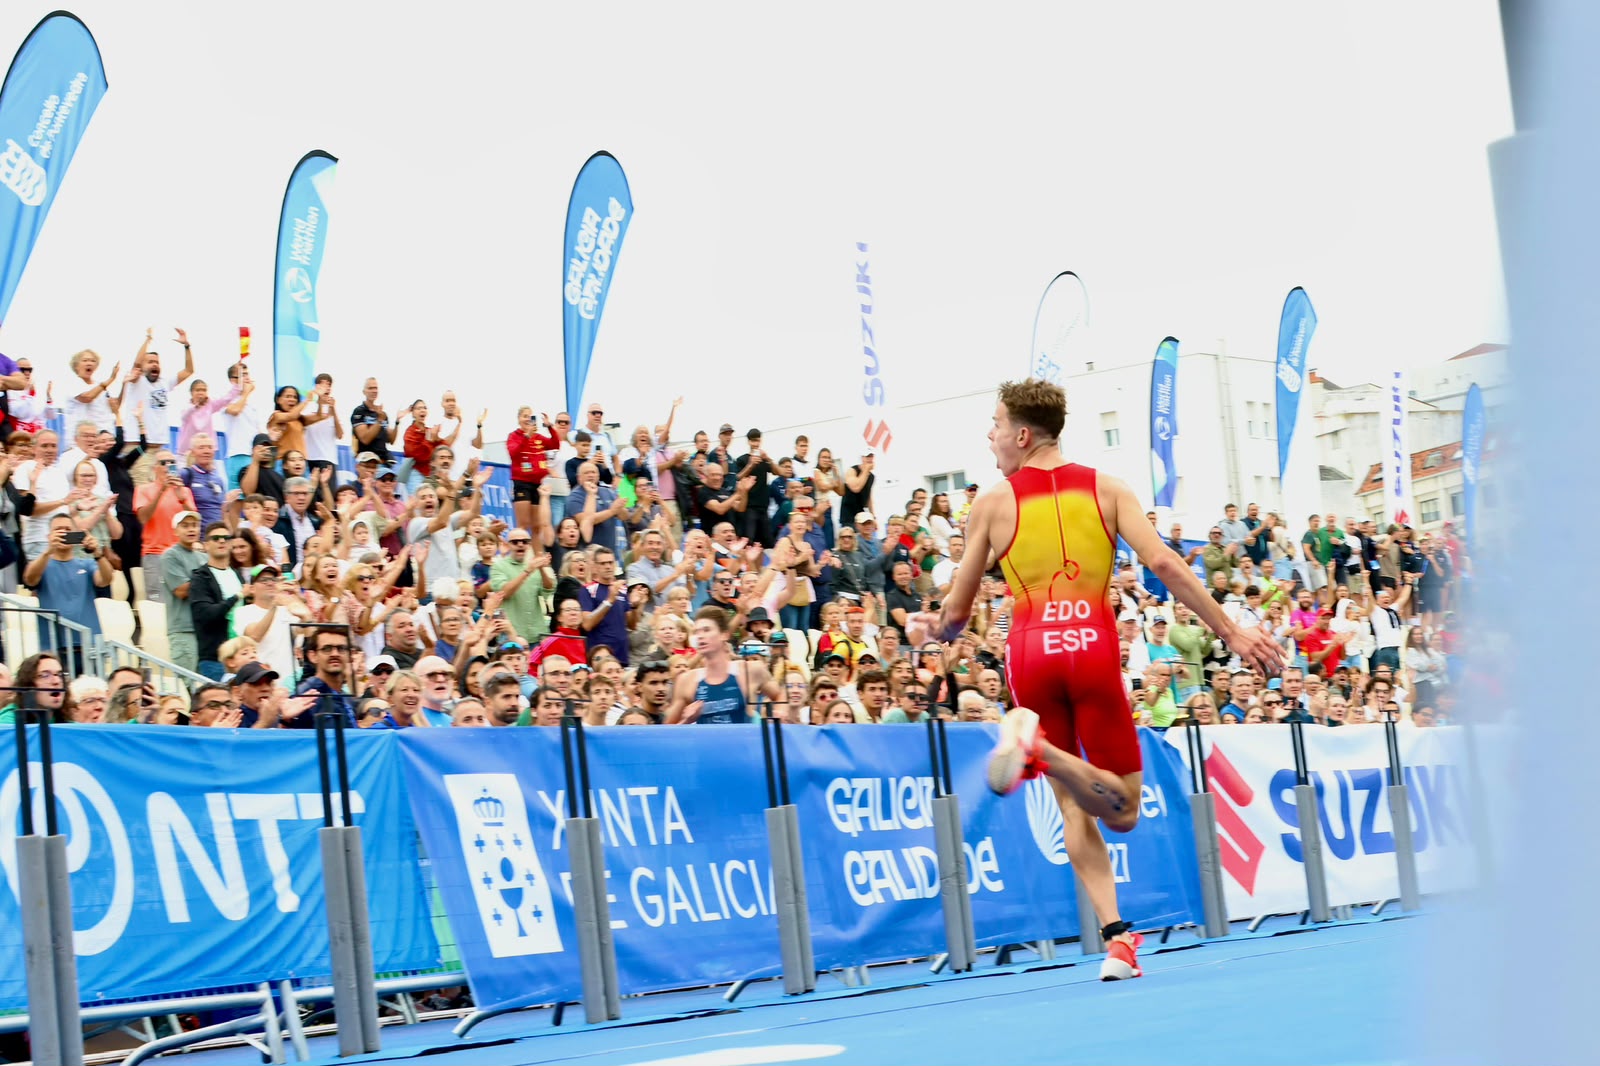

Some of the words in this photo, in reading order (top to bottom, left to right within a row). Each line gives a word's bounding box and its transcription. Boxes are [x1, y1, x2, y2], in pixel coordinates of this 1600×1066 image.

[855, 241, 885, 406] SUZUKI
[1042, 600, 1091, 622] EDO
[1042, 627, 1098, 655] ESP
[842, 836, 1005, 907] CALIDDE
